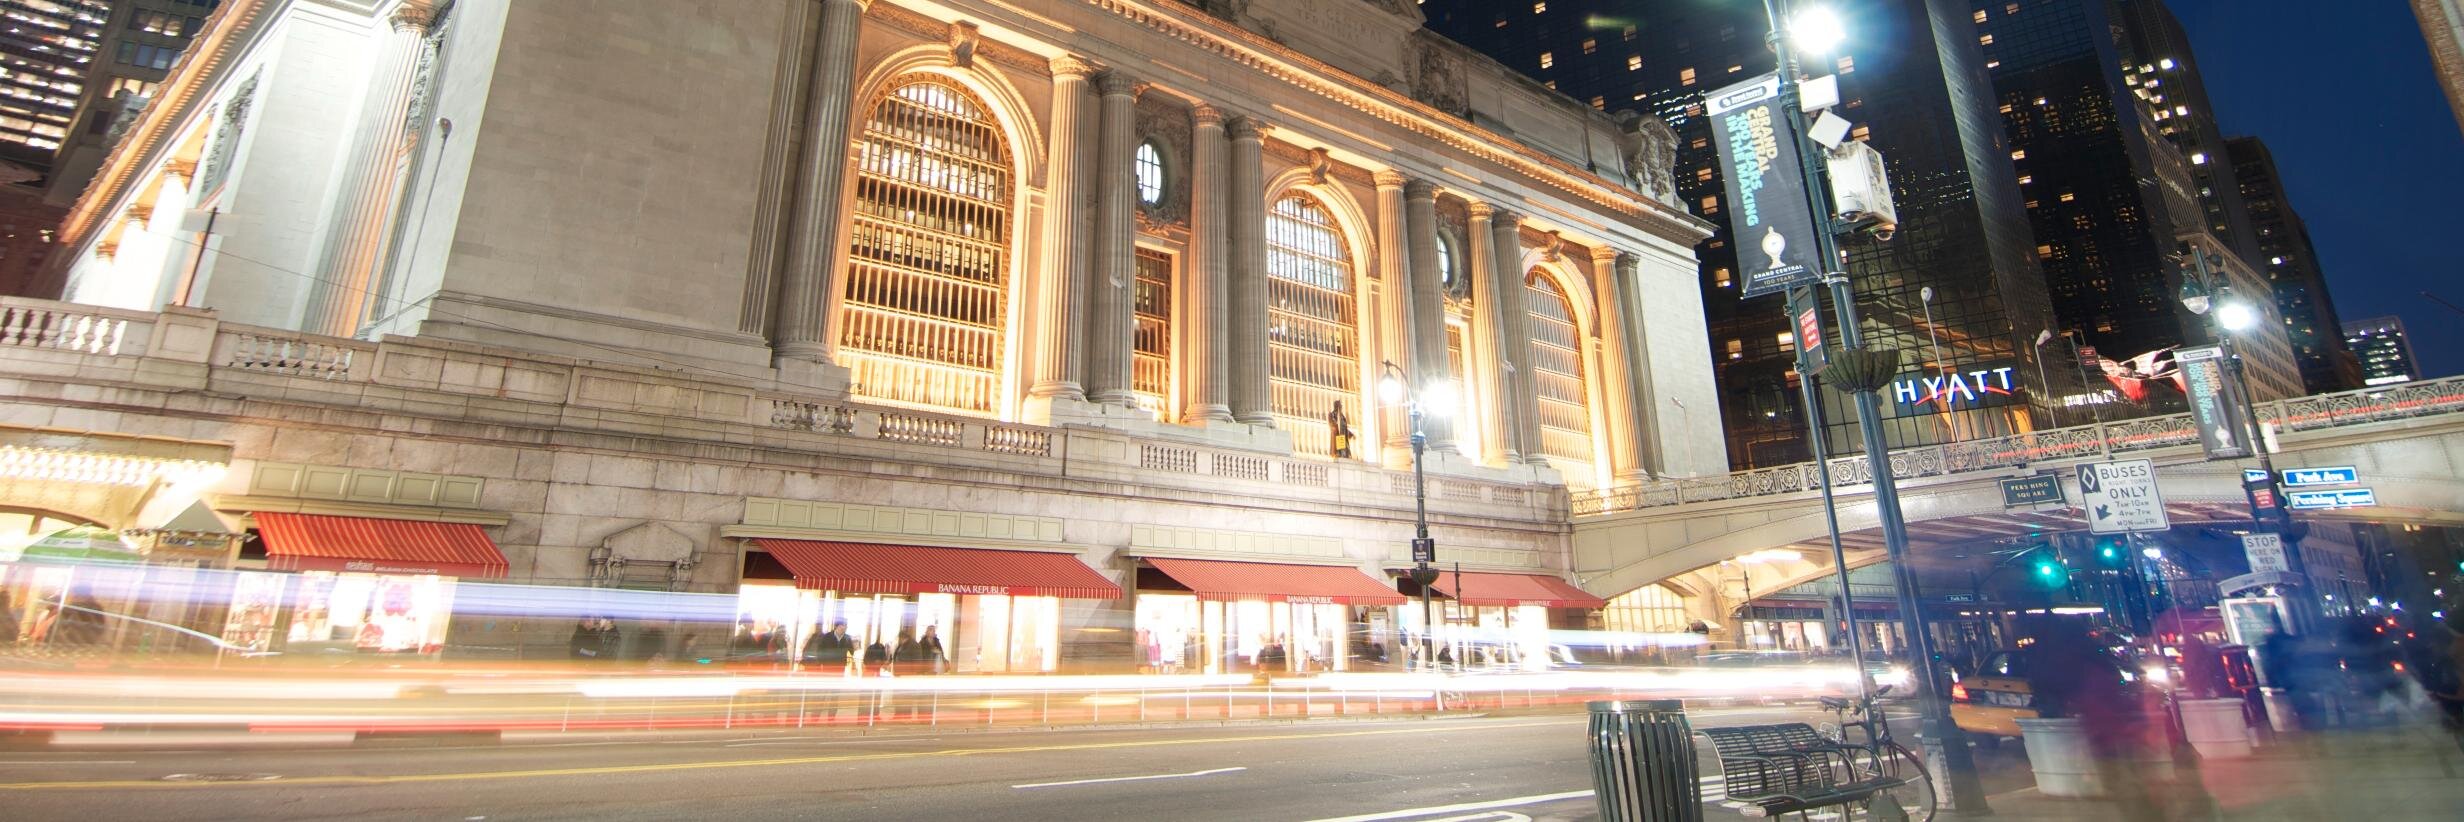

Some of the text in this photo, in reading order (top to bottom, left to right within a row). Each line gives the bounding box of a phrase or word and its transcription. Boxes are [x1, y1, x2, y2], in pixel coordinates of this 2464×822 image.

[1736, 112, 1752, 141] 100
[1756, 105, 1778, 159] GRAND
[1746, 109, 1770, 176] CENTRAL
[1725, 114, 1760, 227] IN THE MAKING
[1741, 140, 1763, 190] YEARS
[1753, 264, 1804, 279] GRAND CENTRAL
[1894, 366, 2013, 403] HYATT
[2100, 465, 2147, 480] BUSES
[2295, 471, 2345, 482] Park Ave
[2010, 481, 2049, 491] PERSHING
[2109, 486, 2148, 499] ONLY
[2016, 490, 2047, 498] SQUARE
[2246, 536, 2278, 548] STOP
[938, 583, 1009, 595] BANANA REPUBLIC
